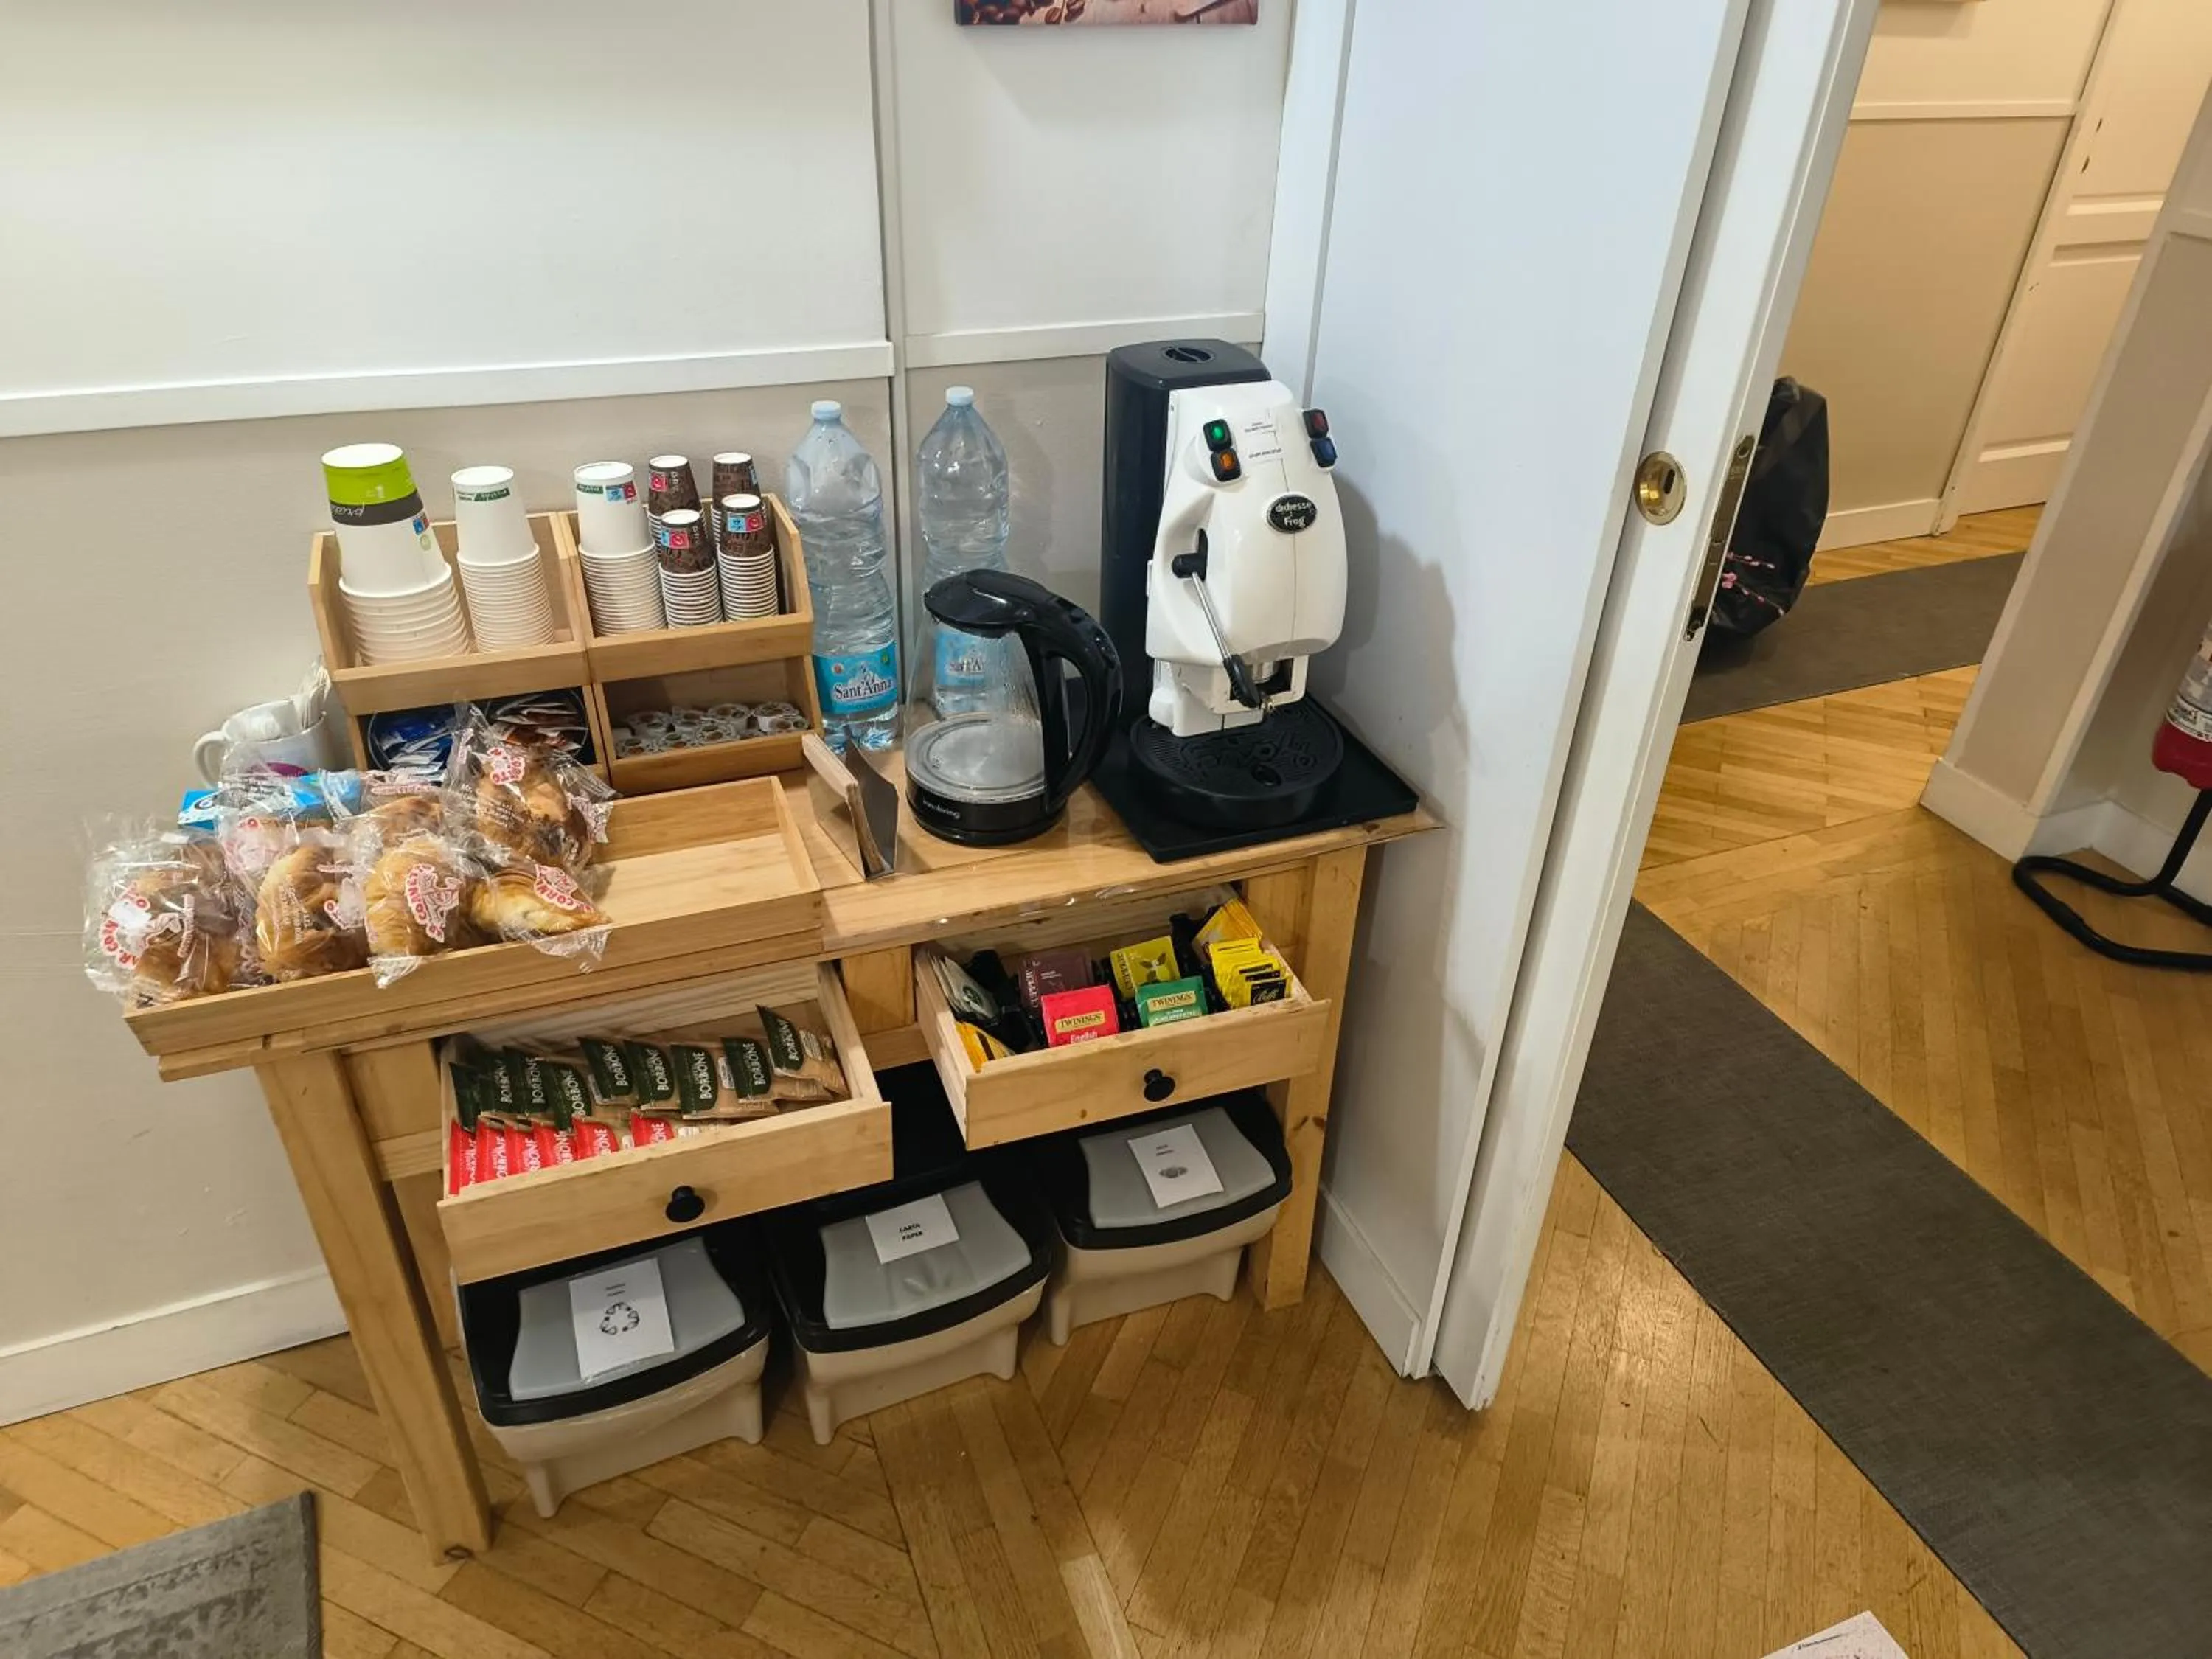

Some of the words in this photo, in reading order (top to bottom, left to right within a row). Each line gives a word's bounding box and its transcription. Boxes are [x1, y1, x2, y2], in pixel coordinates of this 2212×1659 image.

[1284, 517, 1306, 528] Frog
[1152, 994, 1192, 1007] TWININGS
[1060, 1014, 1102, 1028] TWININGS
[743, 1042, 766, 1085] BORBONE
[692, 1051, 712, 1099] BORBONE
